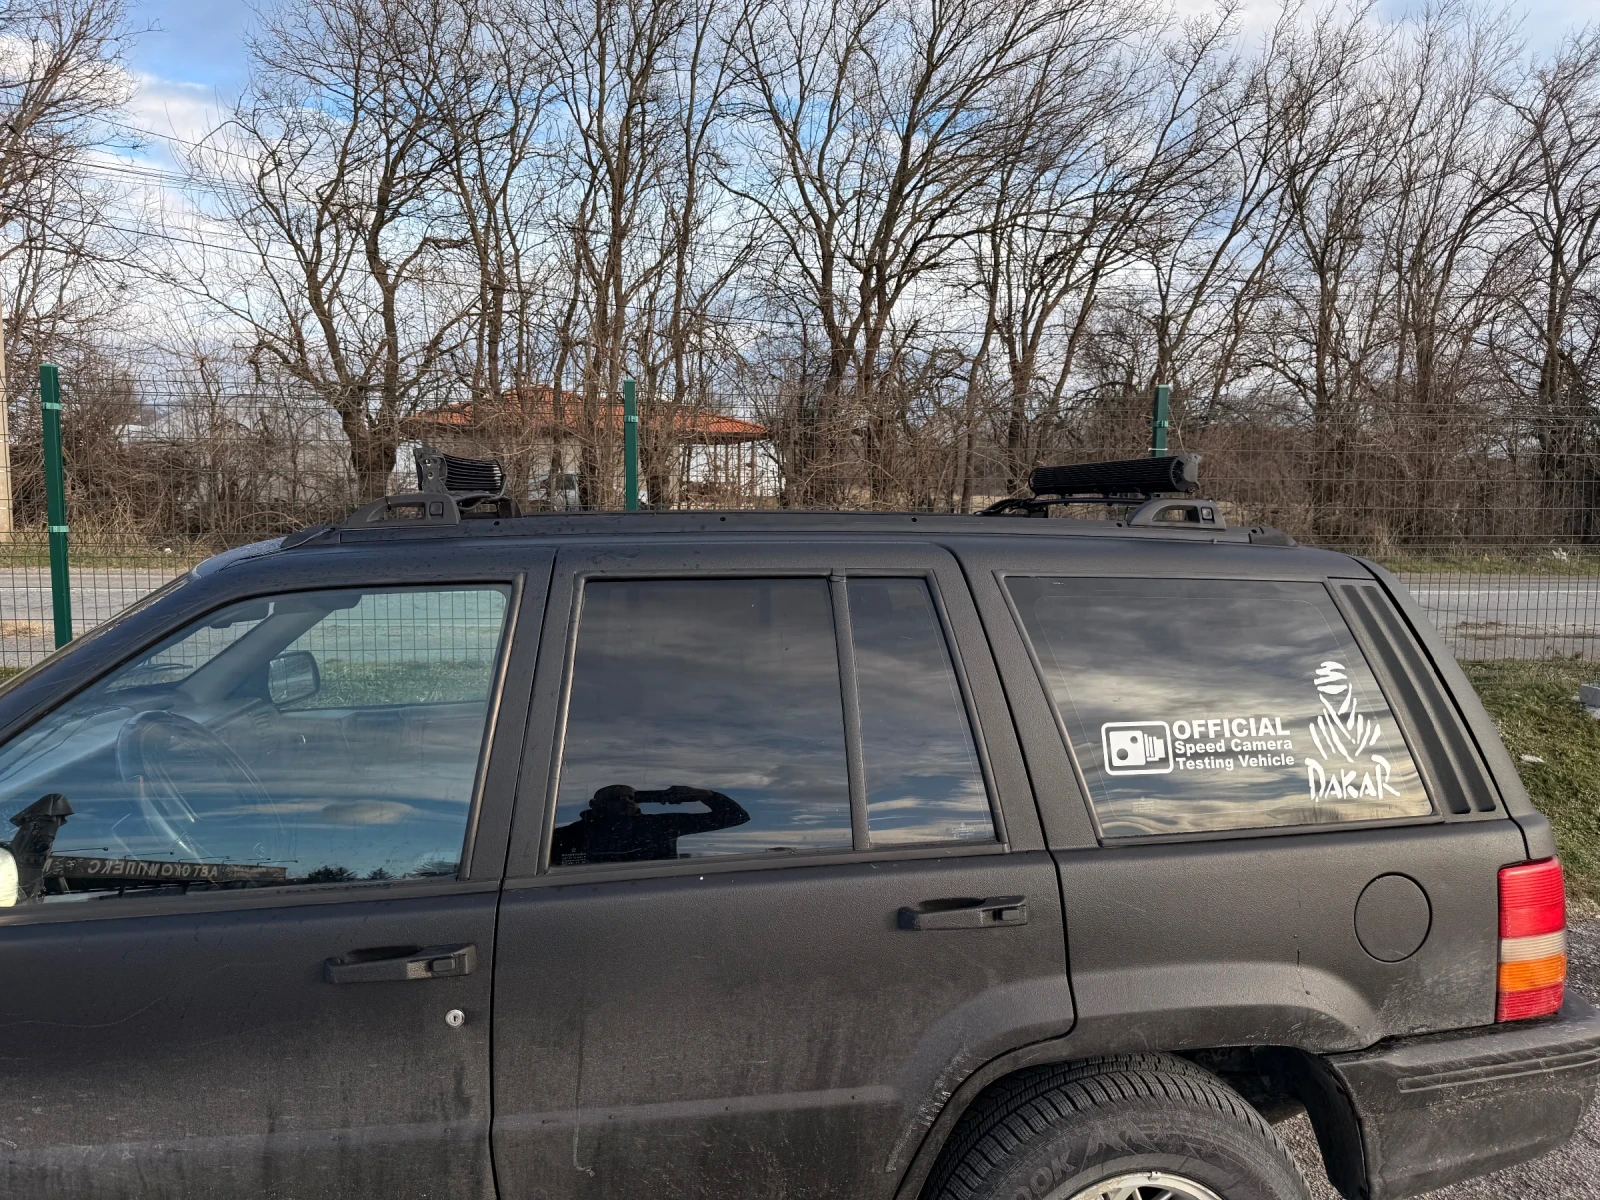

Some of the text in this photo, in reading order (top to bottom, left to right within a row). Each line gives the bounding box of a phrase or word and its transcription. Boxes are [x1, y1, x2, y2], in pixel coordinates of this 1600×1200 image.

[1172, 717, 1291, 740] OFFICIAL
[1174, 738, 1293, 754] Speed Camera
[1175, 753, 1295, 771] Testing Vehicle
[1304, 755, 1401, 802] DAKAR
